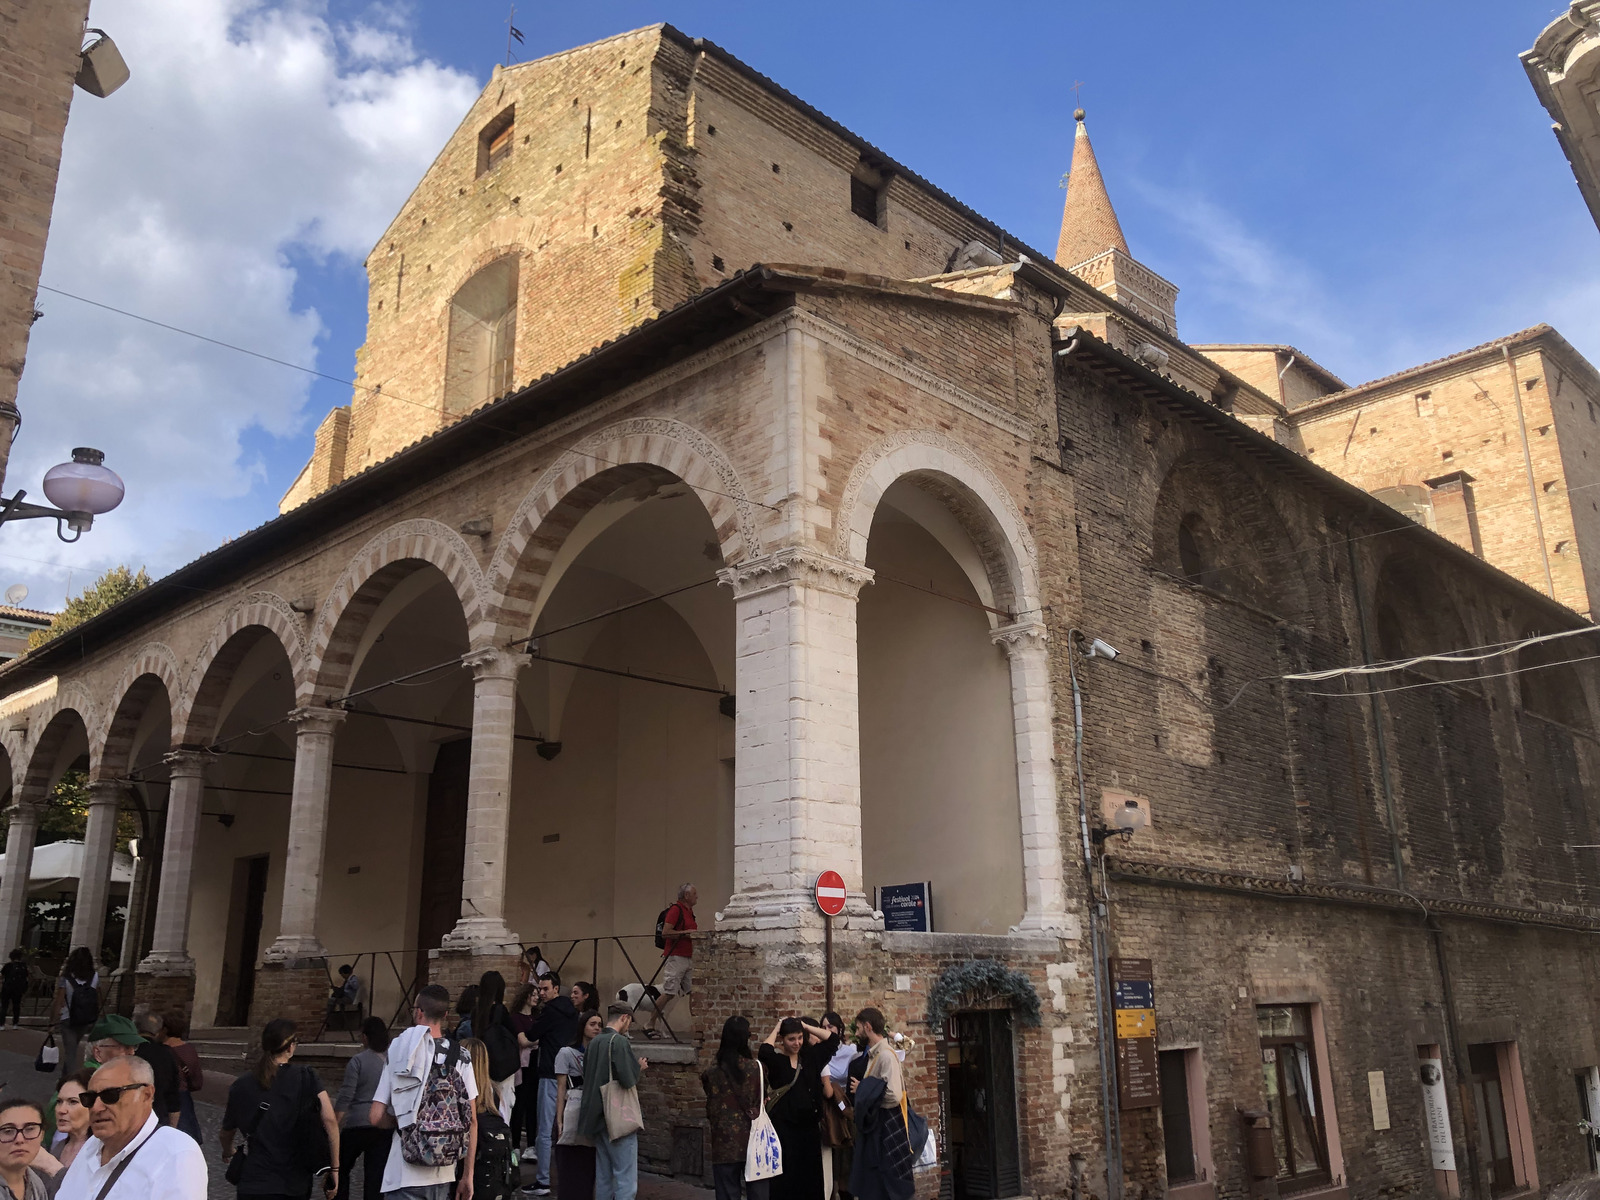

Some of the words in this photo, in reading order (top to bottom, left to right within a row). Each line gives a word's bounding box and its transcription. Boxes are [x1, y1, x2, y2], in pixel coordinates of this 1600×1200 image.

[891, 895, 910, 904] festival
[1428, 1096, 1438, 1132] TRATTORIA
[1434, 1135, 1439, 1143] LA
